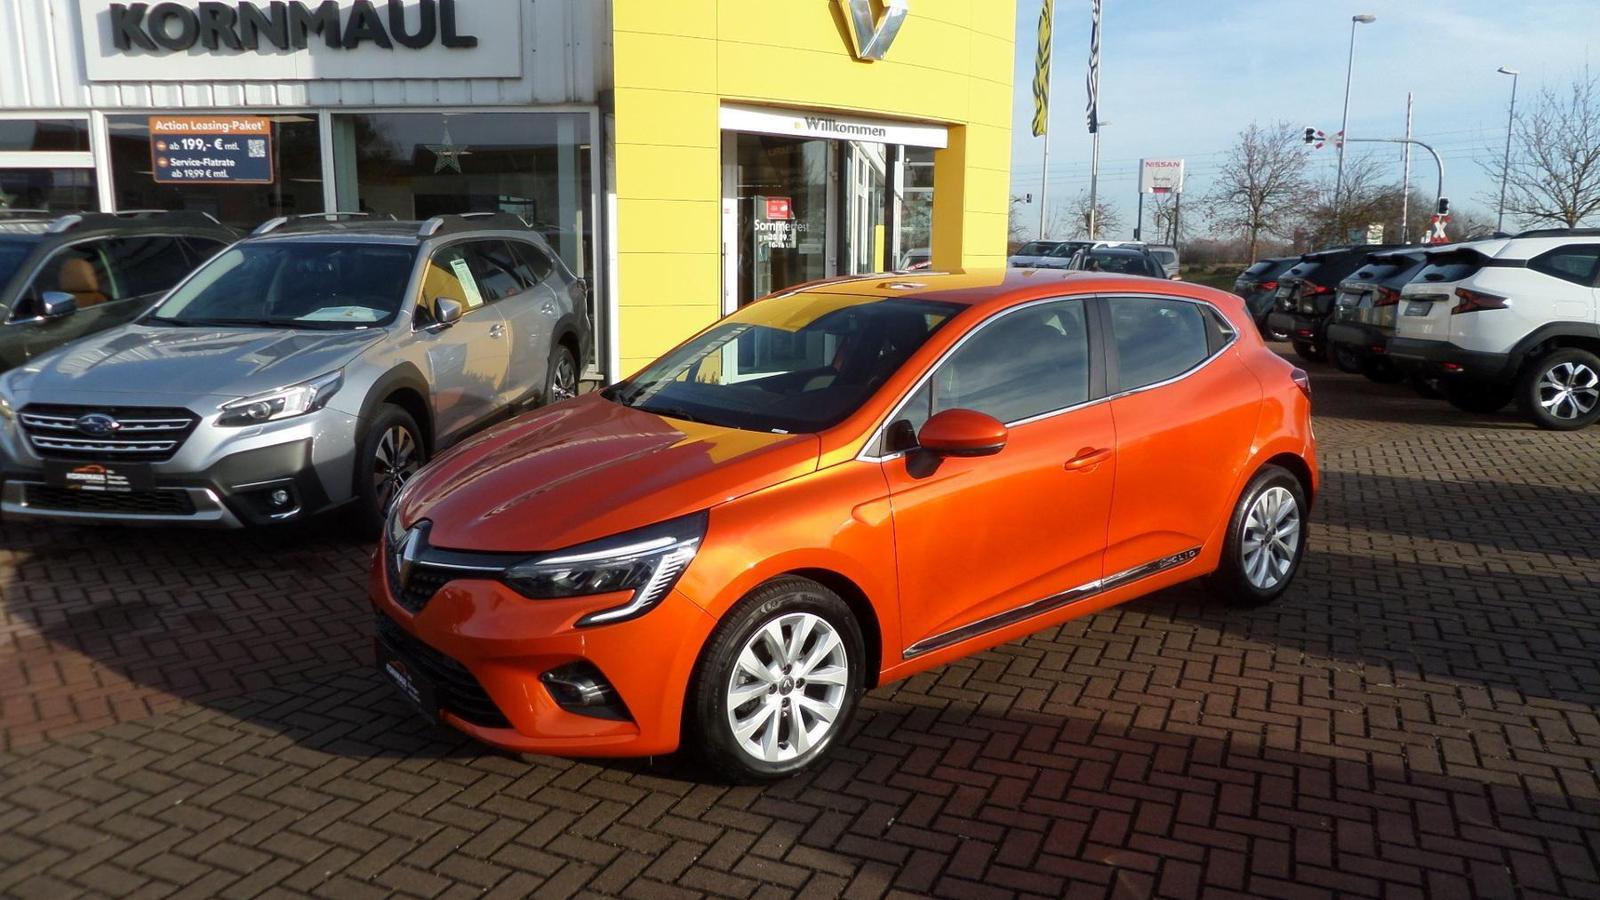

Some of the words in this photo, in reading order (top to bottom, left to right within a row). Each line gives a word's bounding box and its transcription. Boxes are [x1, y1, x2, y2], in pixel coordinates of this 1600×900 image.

[109, 0, 478, 49] KORNMAUL
[155, 121, 189, 130] Action
[804, 116, 887, 137] Willkommen
[169, 142, 180, 150] ab
[181, 138, 212, 151] 199,-
[214, 138, 223, 150] €
[224, 142, 240, 150] mtl.
[170, 158, 236, 167] Service-Flatrate
[172, 169, 183, 178] ab
[206, 169, 212, 177] €
